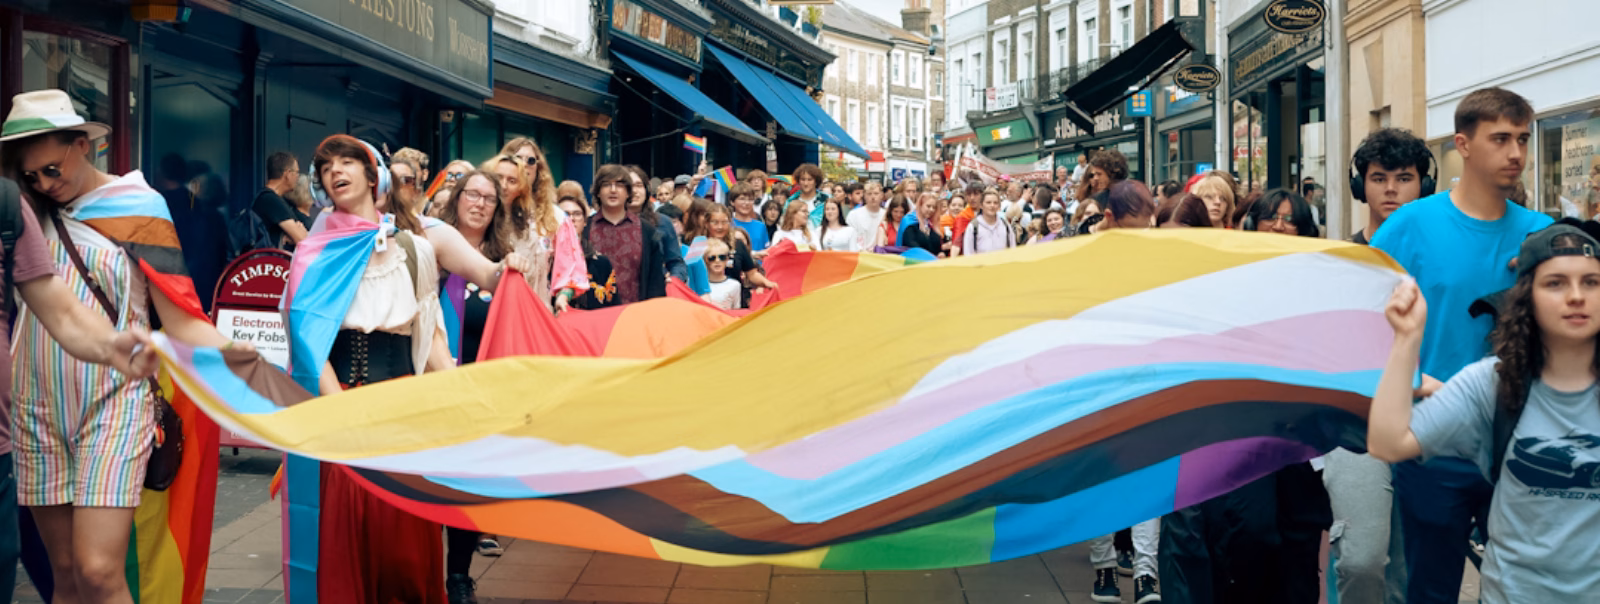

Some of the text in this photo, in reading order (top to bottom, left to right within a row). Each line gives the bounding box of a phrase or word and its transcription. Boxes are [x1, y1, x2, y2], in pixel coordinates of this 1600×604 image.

[1270, 3, 1319, 19] Harriets
[349, 0, 435, 42] STONS
[232, 329, 286, 343] Key Fobs
